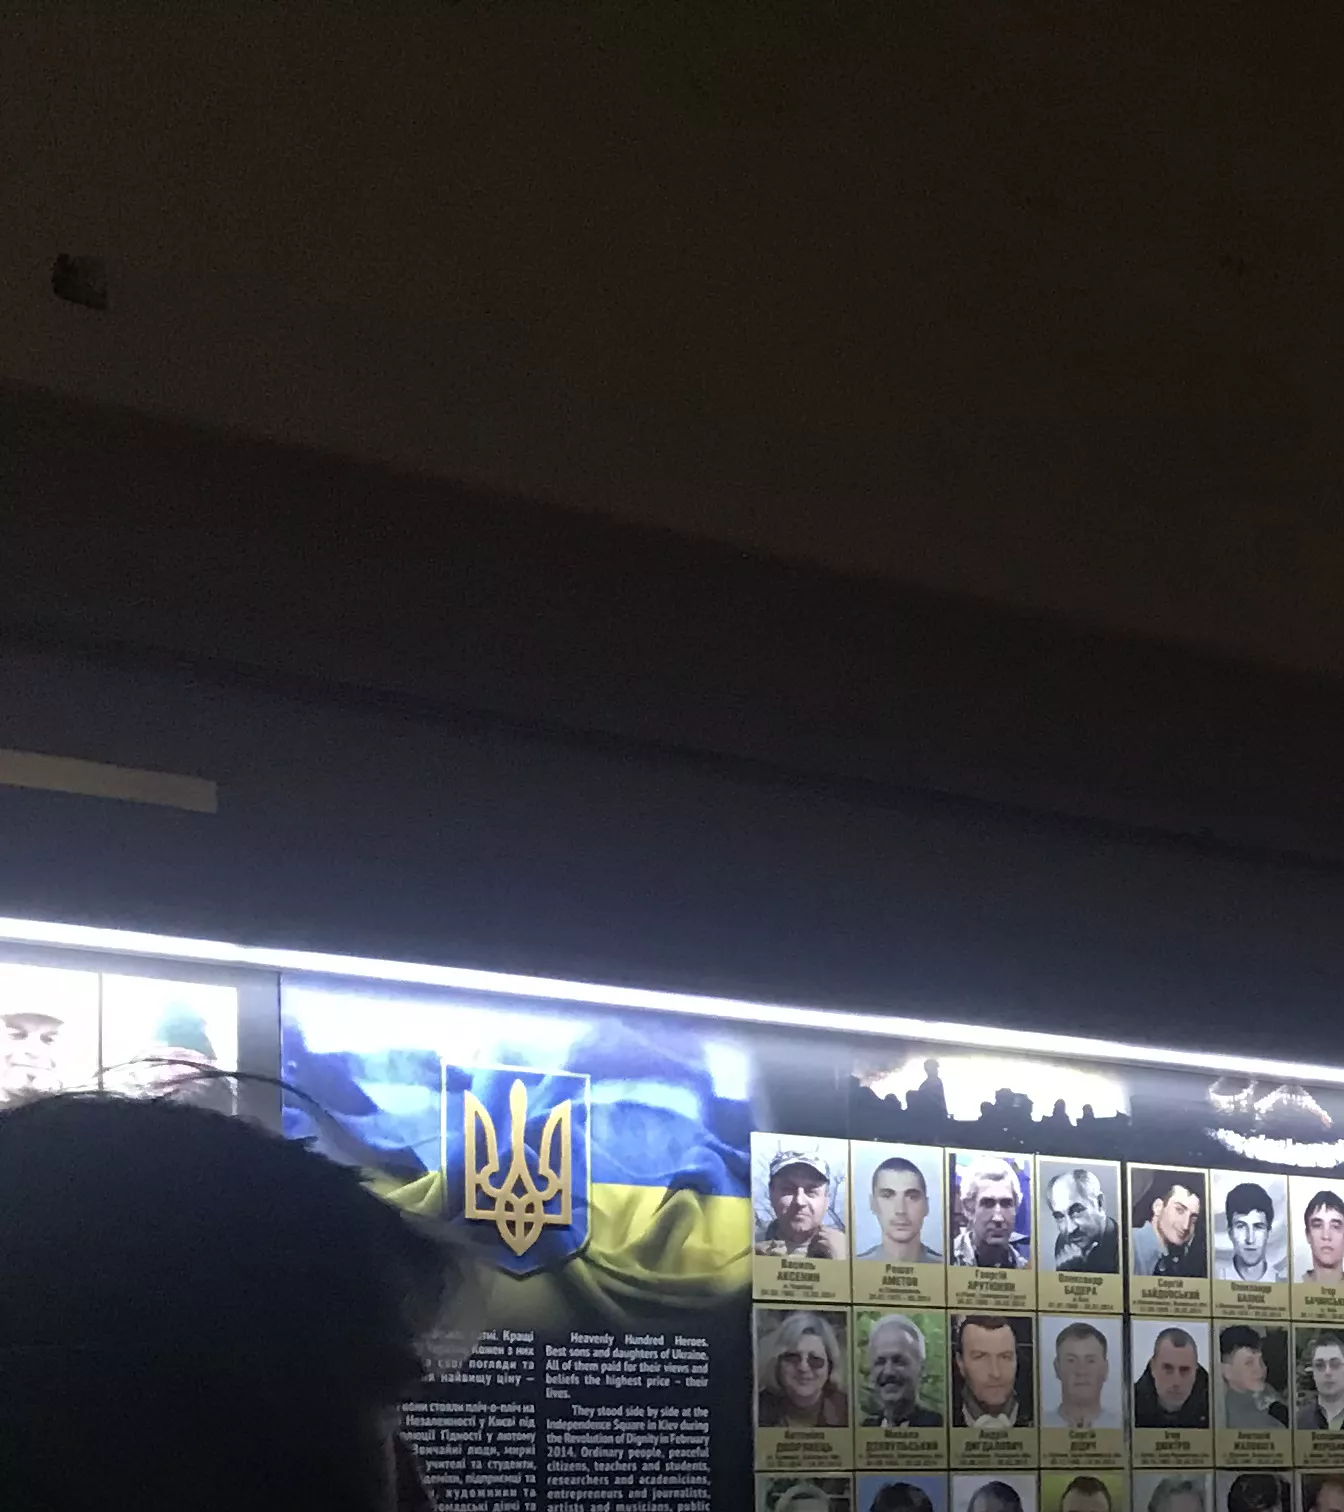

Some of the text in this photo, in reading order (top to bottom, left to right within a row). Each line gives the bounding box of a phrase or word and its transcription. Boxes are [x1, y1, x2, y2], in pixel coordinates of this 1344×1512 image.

[781, 1260, 815, 1269] Василь
[882, 1276, 918, 1286] АМЕТОВ
[503, 1329, 534, 1343] Кращі
[570, 1332, 708, 1347] Heavenly Hundred Heroes.
[472, 1344, 504, 1355] Кожен
[516, 1346, 535, 1356] них
[545, 1345, 567, 1356] Best
[569, 1347, 590, 1356] sons
[593, 1347, 610, 1357] and
[613, 1347, 658, 1360] daughters
[660, 1349, 669, 1358] of
[469, 1359, 534, 1370] погляди та
[545, 1360, 708, 1373] All of them paid for their views and
[441, 1373, 521, 1386] найвищу ціну
[545, 1373, 708, 1387] beliefs the highest price their
[545, 1388, 570, 1398] lives.
[572, 1405, 709, 1419] They stood side by side at the
[406, 1414, 476, 1426] Незалежності
[488, 1416, 516, 1426] Києві
[547, 1419, 709, 1433] Independence Square in Kiev during
[441, 1430, 482, 1441] Гідності
[547, 1434, 710, 1446] the Revolution of Dignity in February
[412, 1444, 462, 1455] Звичайні
[504, 1446, 536, 1457] мирні
[581, 1447, 623, 1459] Ordinary
[669, 1447, 709, 1459] peaceful
[471, 1460, 482, 1469] та
[547, 1462, 710, 1472] citizens, teachers and students,
[525, 1475, 536, 1484] та
[547, 1475, 609, 1485] researchers
[614, 1475, 634, 1485] and
[445, 1489, 536, 1500] художники та
[547, 1489, 623, 1500] entrepreneurs
[629, 1488, 647, 1498] and
[525, 1503, 536, 1511] та
[547, 1502, 584, 1512] artists
[590, 1502, 610, 1512] and
[677, 1502, 711, 1512] public
